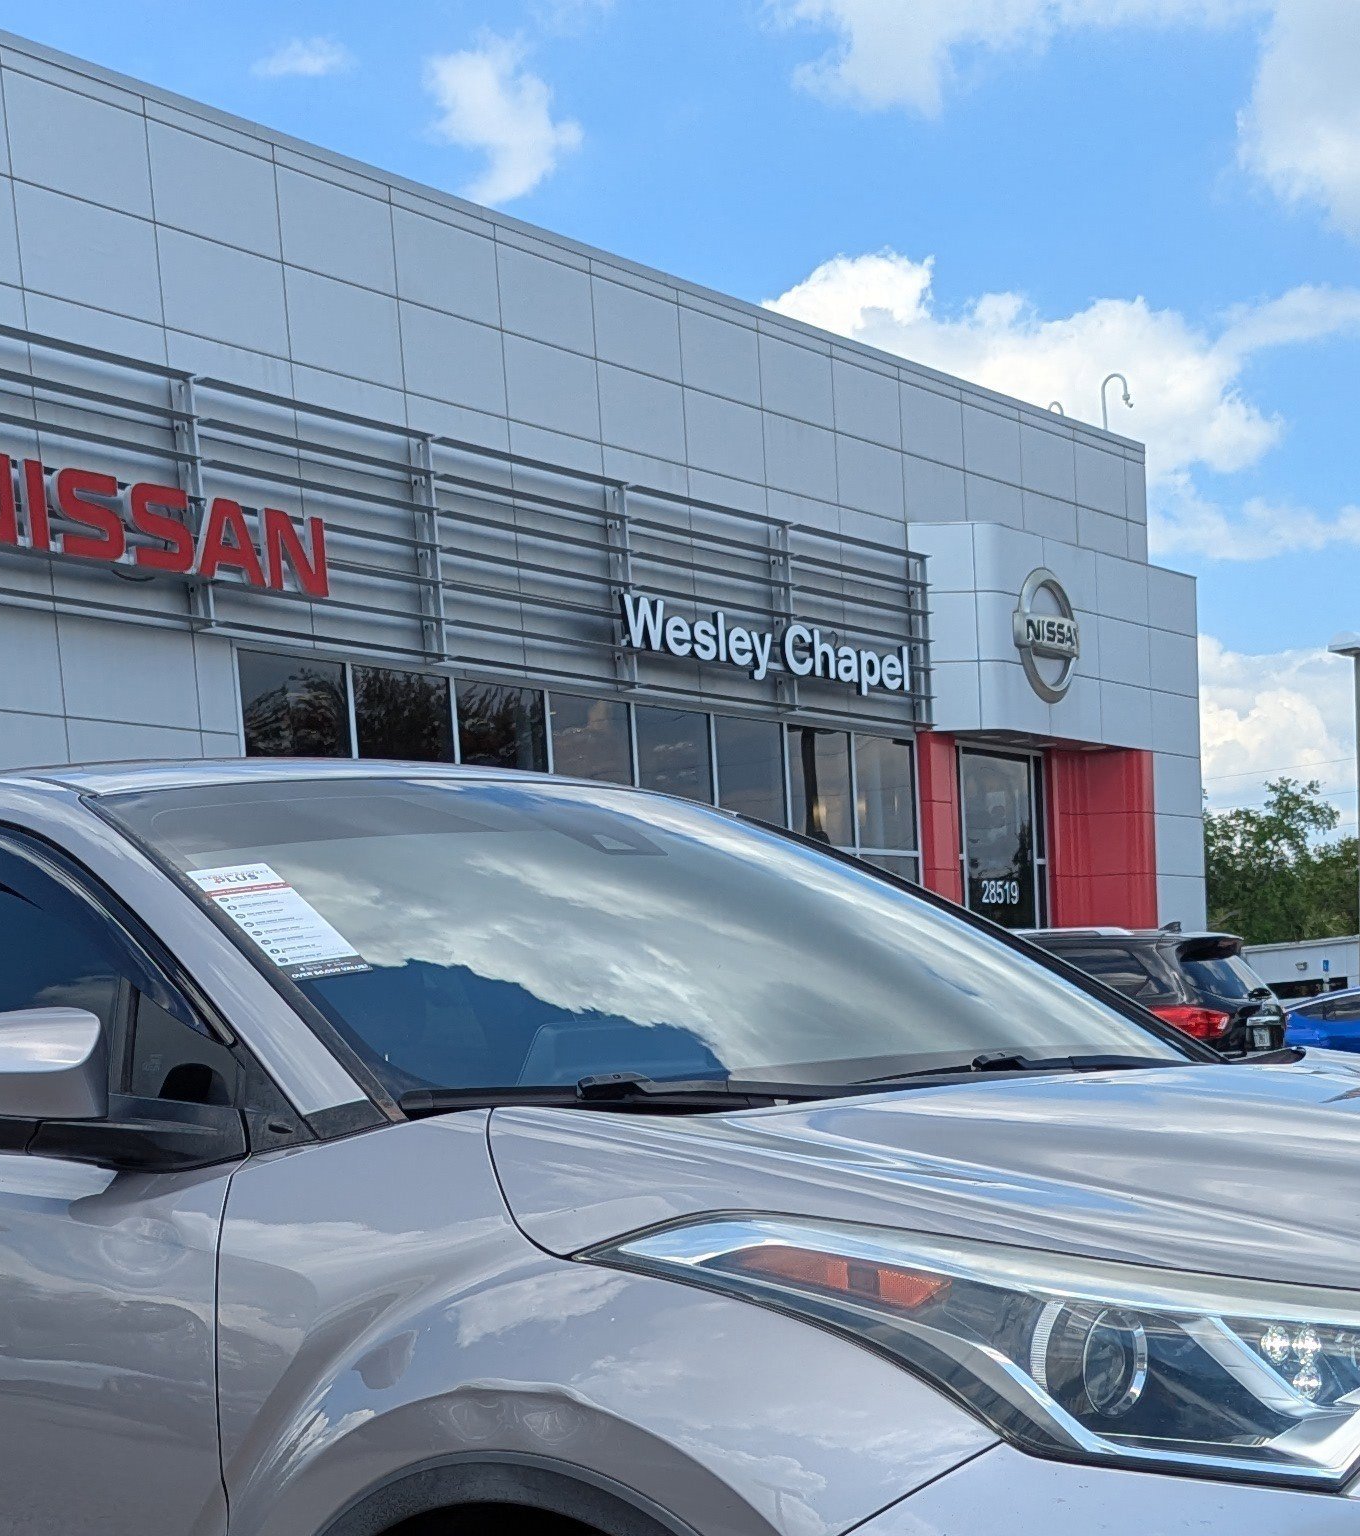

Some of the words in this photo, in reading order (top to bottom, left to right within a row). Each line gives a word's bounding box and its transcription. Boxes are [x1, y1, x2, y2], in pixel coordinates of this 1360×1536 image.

[621, 592, 773, 681] Wesley
[783, 623, 912, 697] Chapel
[981, 879, 1020, 905] 28519
